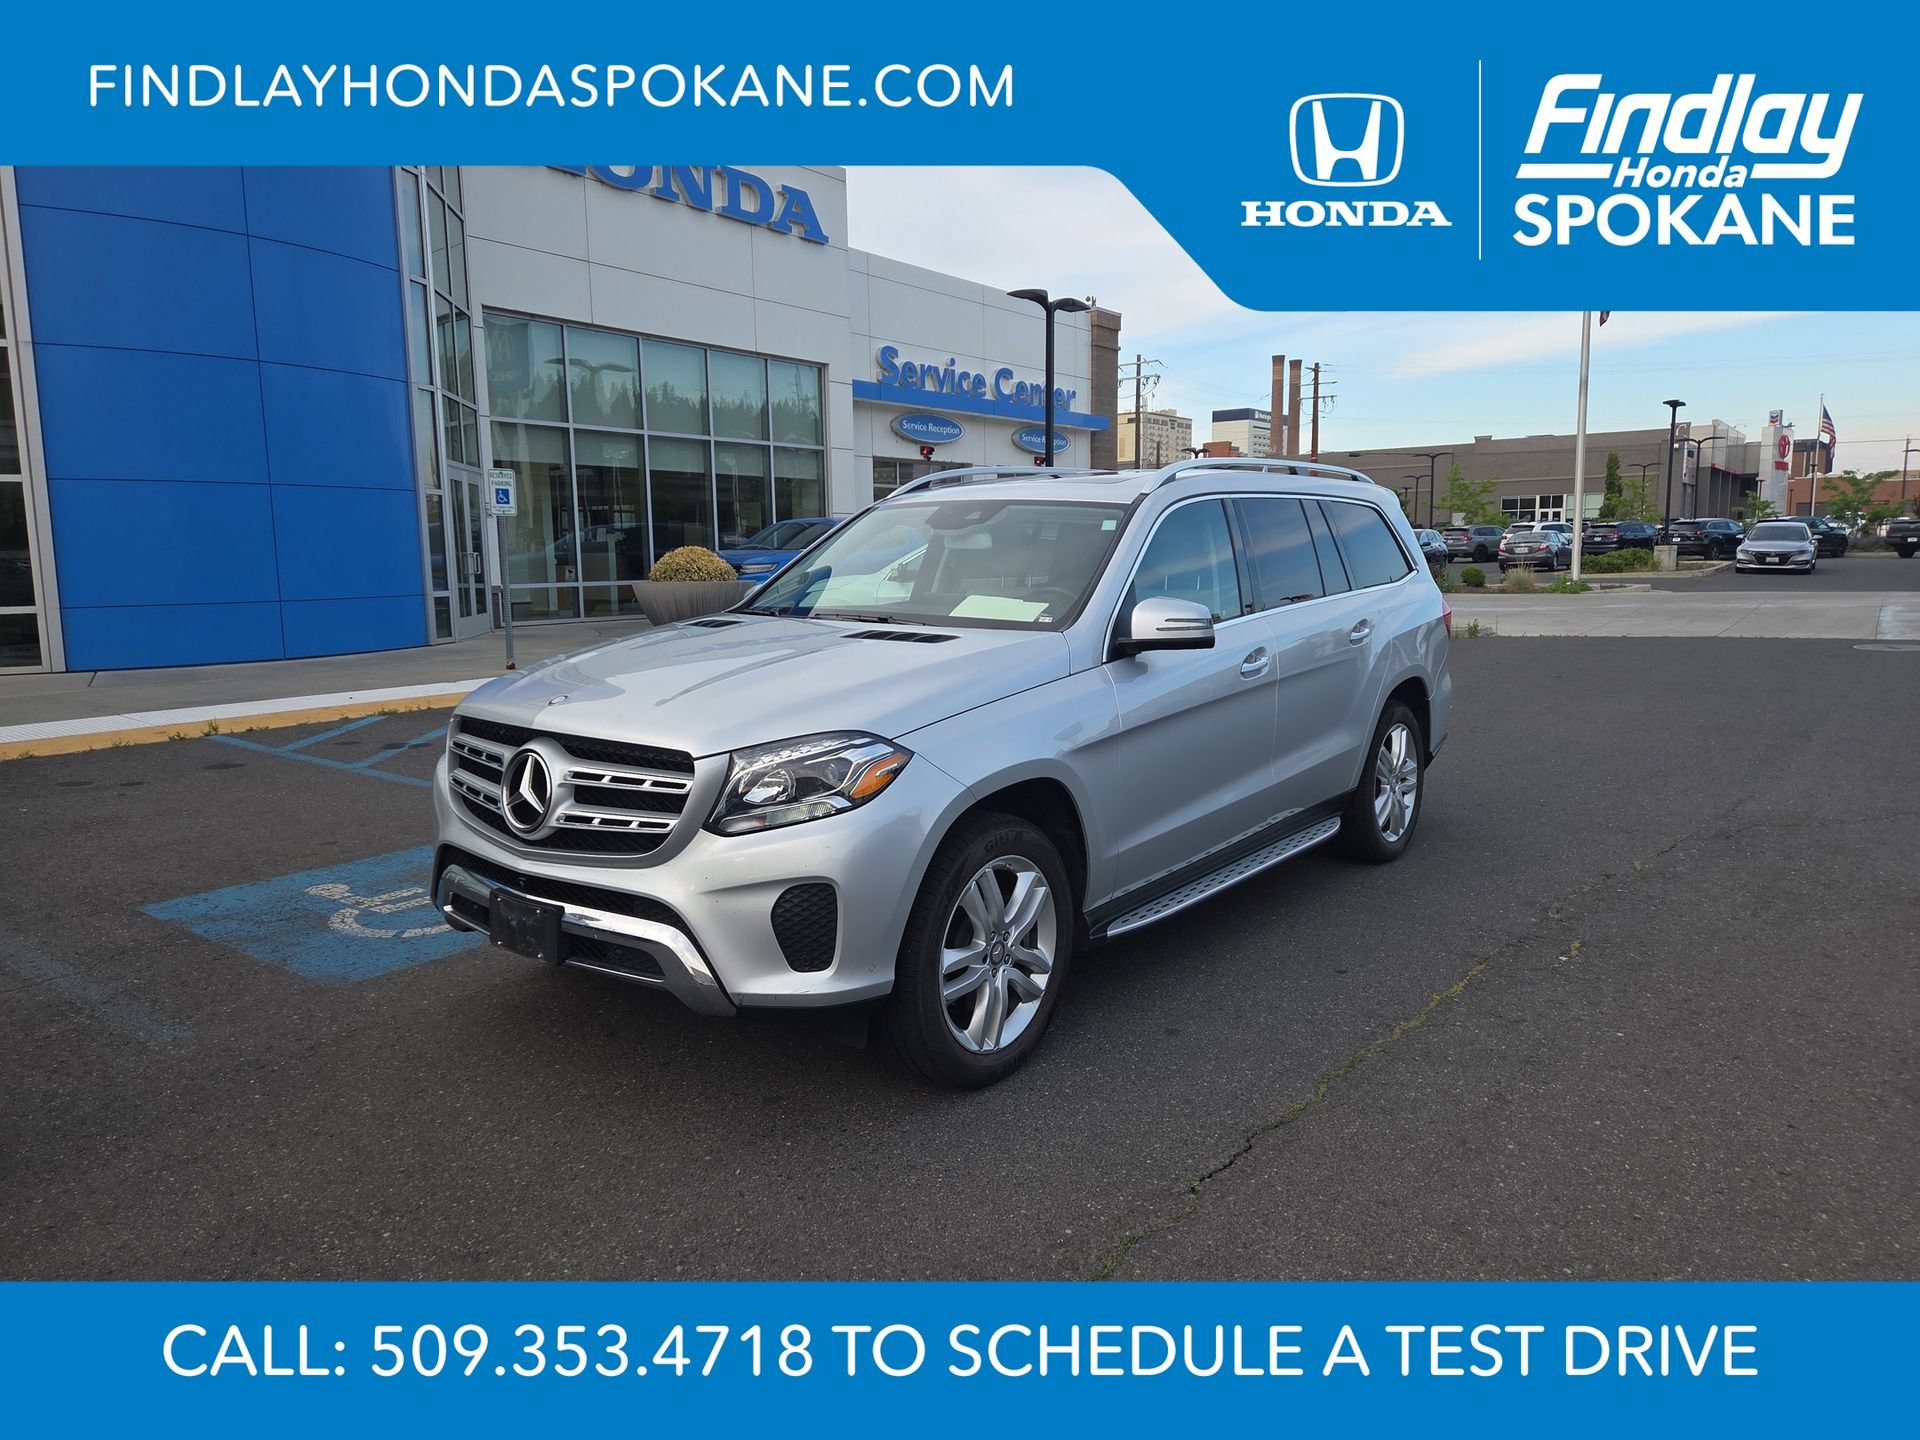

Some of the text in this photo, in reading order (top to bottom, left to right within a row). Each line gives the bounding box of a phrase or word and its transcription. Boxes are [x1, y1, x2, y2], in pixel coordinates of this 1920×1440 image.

[545, 165, 829, 244] NDA
[876, 345, 1077, 411] Service Cener
[902, 420, 960, 435] Service Reception
[1022, 433, 1067, 446] Service Rption
